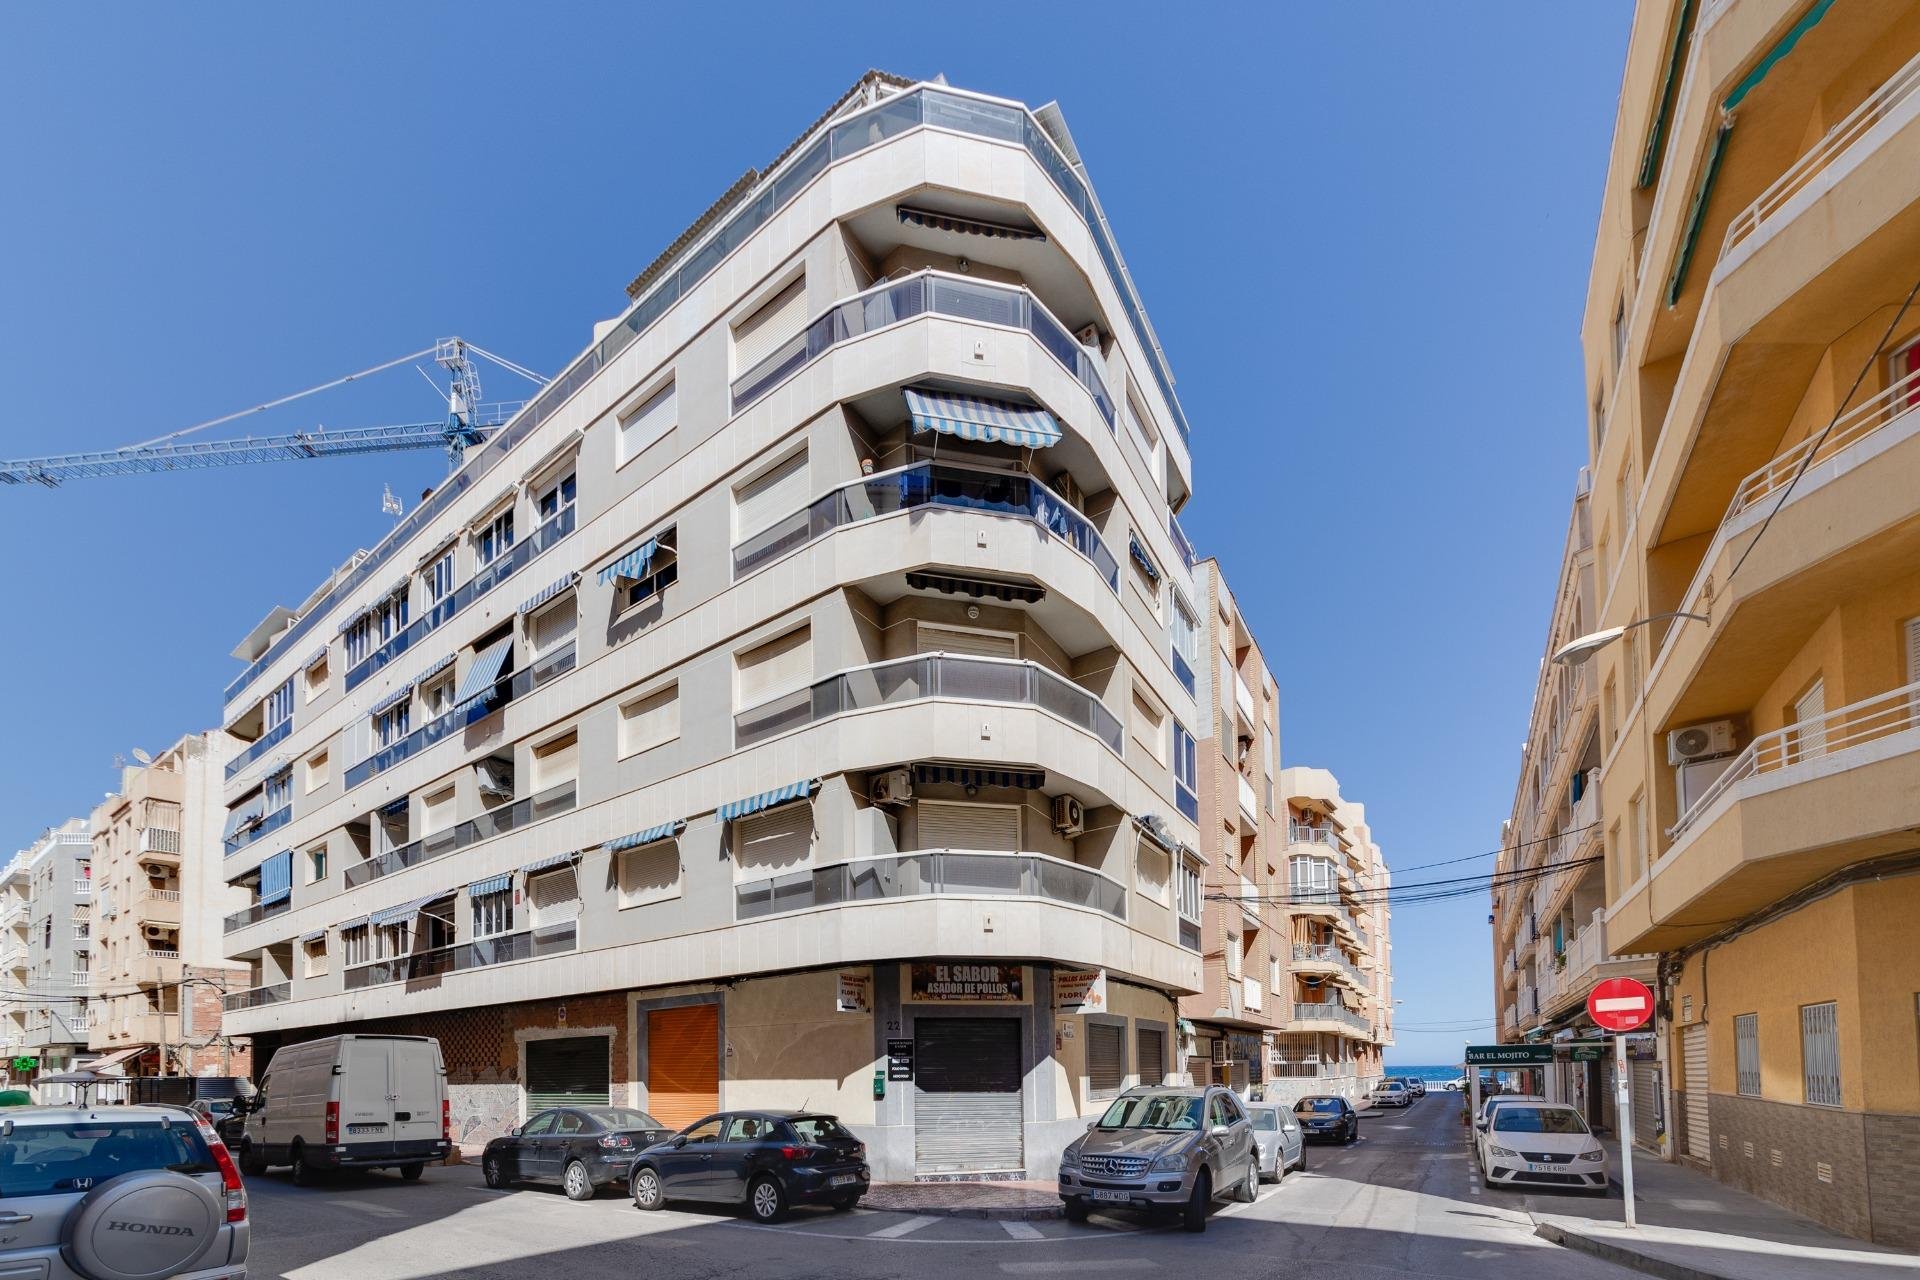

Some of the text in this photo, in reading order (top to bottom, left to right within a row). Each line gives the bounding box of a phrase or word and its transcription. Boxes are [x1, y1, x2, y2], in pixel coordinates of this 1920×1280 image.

[936, 965, 1000, 983] EL SABOR
[927, 982, 1009, 994] ASADOR DE POLLOS
[1058, 991, 1082, 999] FLORI
[887, 1020, 901, 1031] 22
[1468, 1052, 1485, 1060] BAR
[1498, 1051, 1530, 1060] MOJITO
[108, 1220, 195, 1237] HONDA
